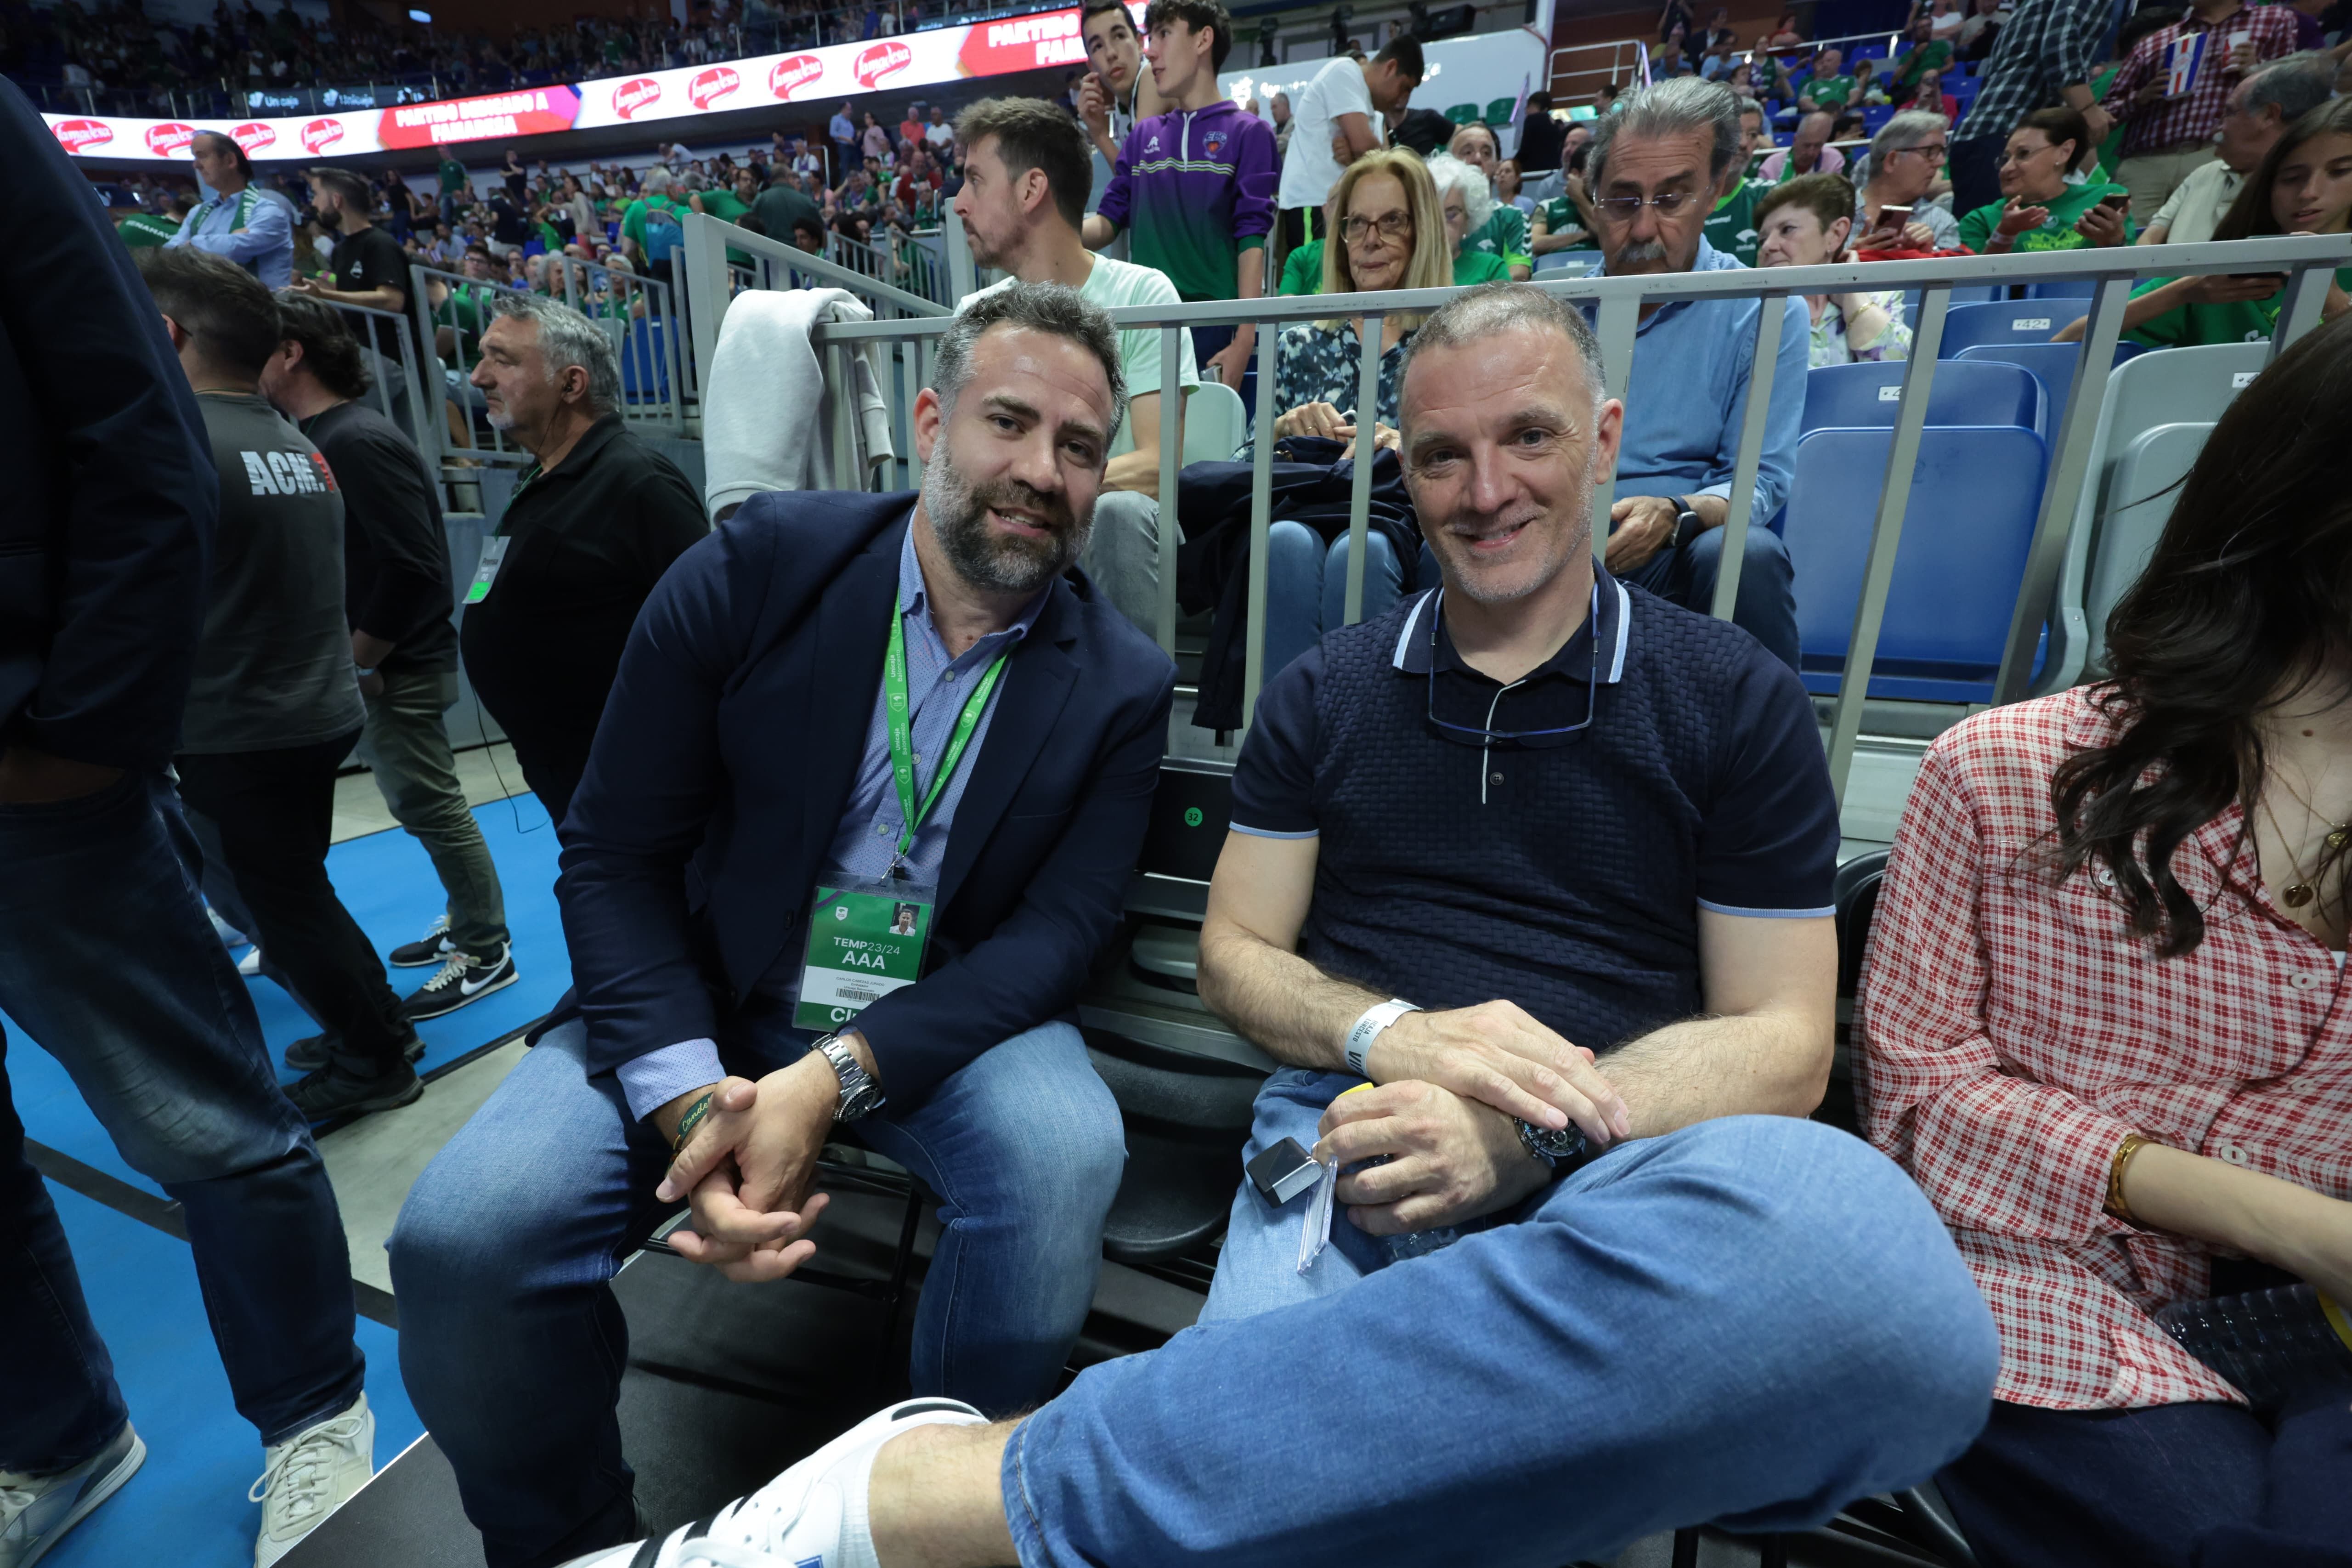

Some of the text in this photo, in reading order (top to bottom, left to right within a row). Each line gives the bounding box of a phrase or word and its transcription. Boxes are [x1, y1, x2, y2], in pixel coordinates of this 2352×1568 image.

[988, 14, 1079, 47] PARTIDO
[772, 57, 821, 91] famadesa
[857, 45, 910, 83] famadesa
[615, 80, 660, 113] famadesa
[690, 69, 739, 103] famadesa
[395, 104, 458, 127] PARTIDO
[459, 94, 534, 119] DEDICADO
[536, 92, 548, 110] A
[430, 115, 518, 142] FAMADESA
[975, 678, 989, 697] Unicaja
[1188, 813, 1199, 821] 32
[842, 951, 885, 970] AAA
[1348, 1051, 1364, 1074] VIP
